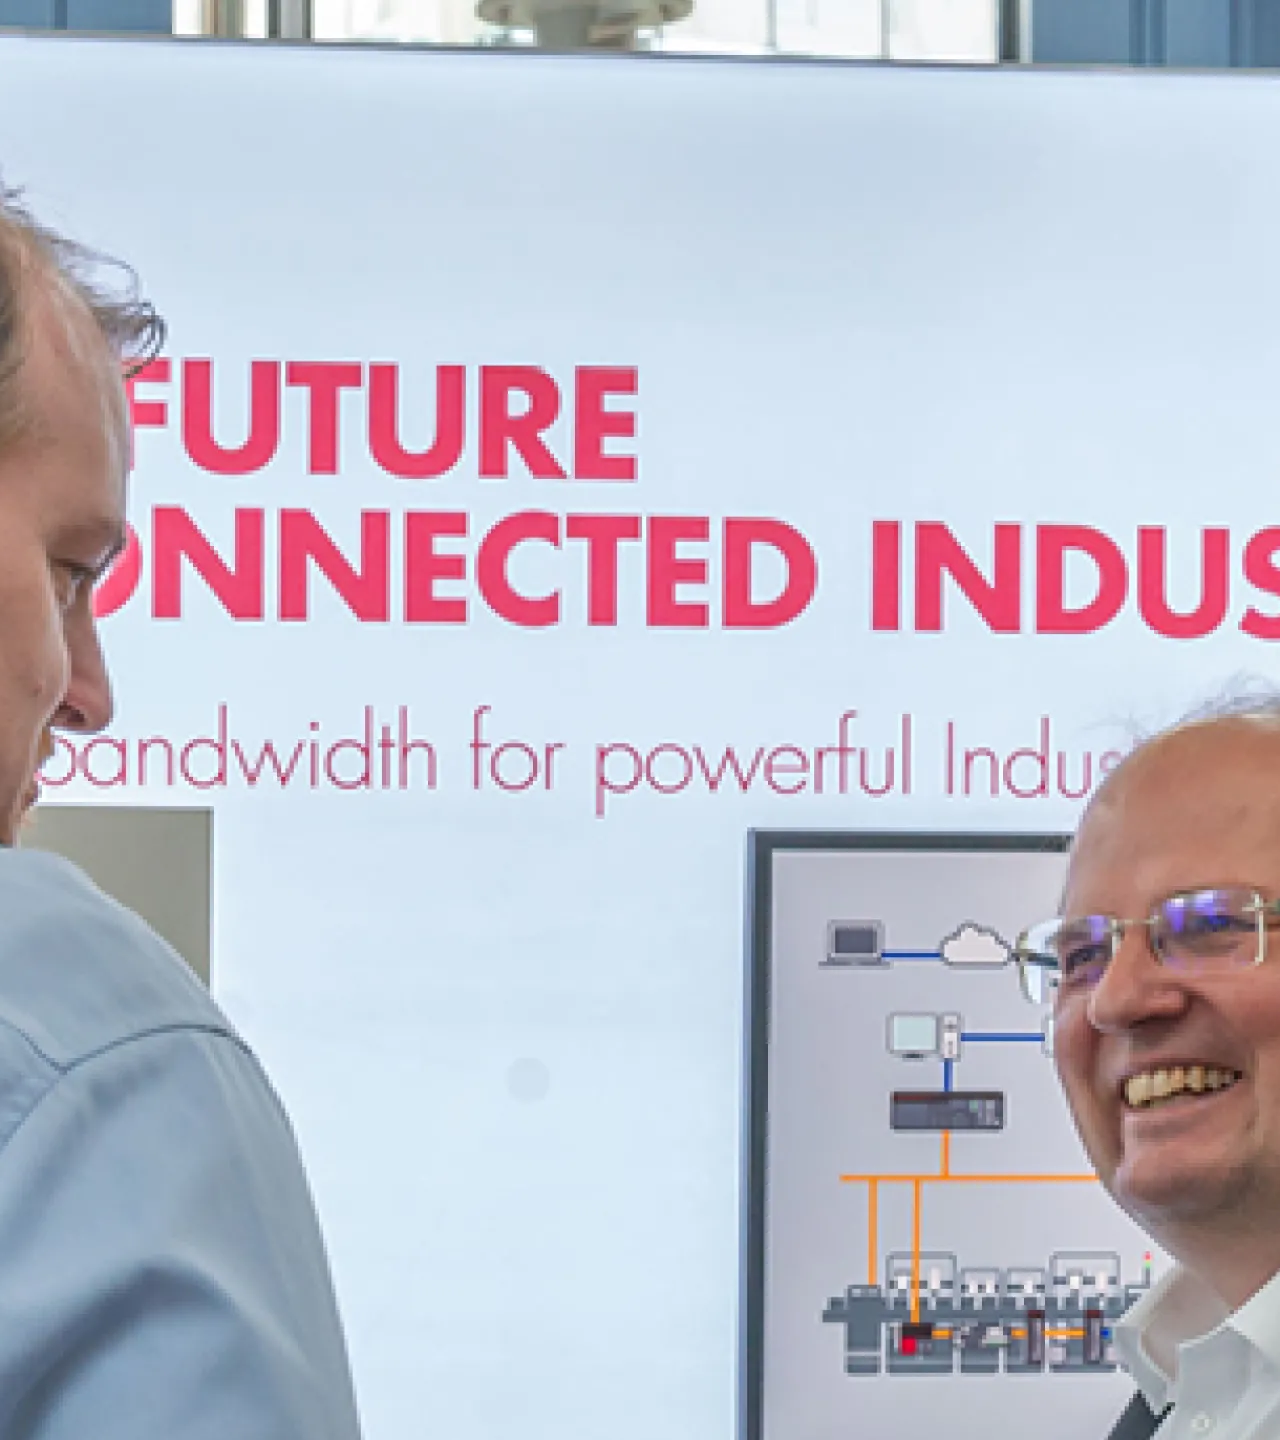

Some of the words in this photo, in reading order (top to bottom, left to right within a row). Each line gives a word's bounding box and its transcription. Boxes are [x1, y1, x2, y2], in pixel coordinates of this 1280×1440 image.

[122, 357, 638, 481] FUTURE
[470, 704, 566, 792] for
[595, 709, 911, 817] powerful
